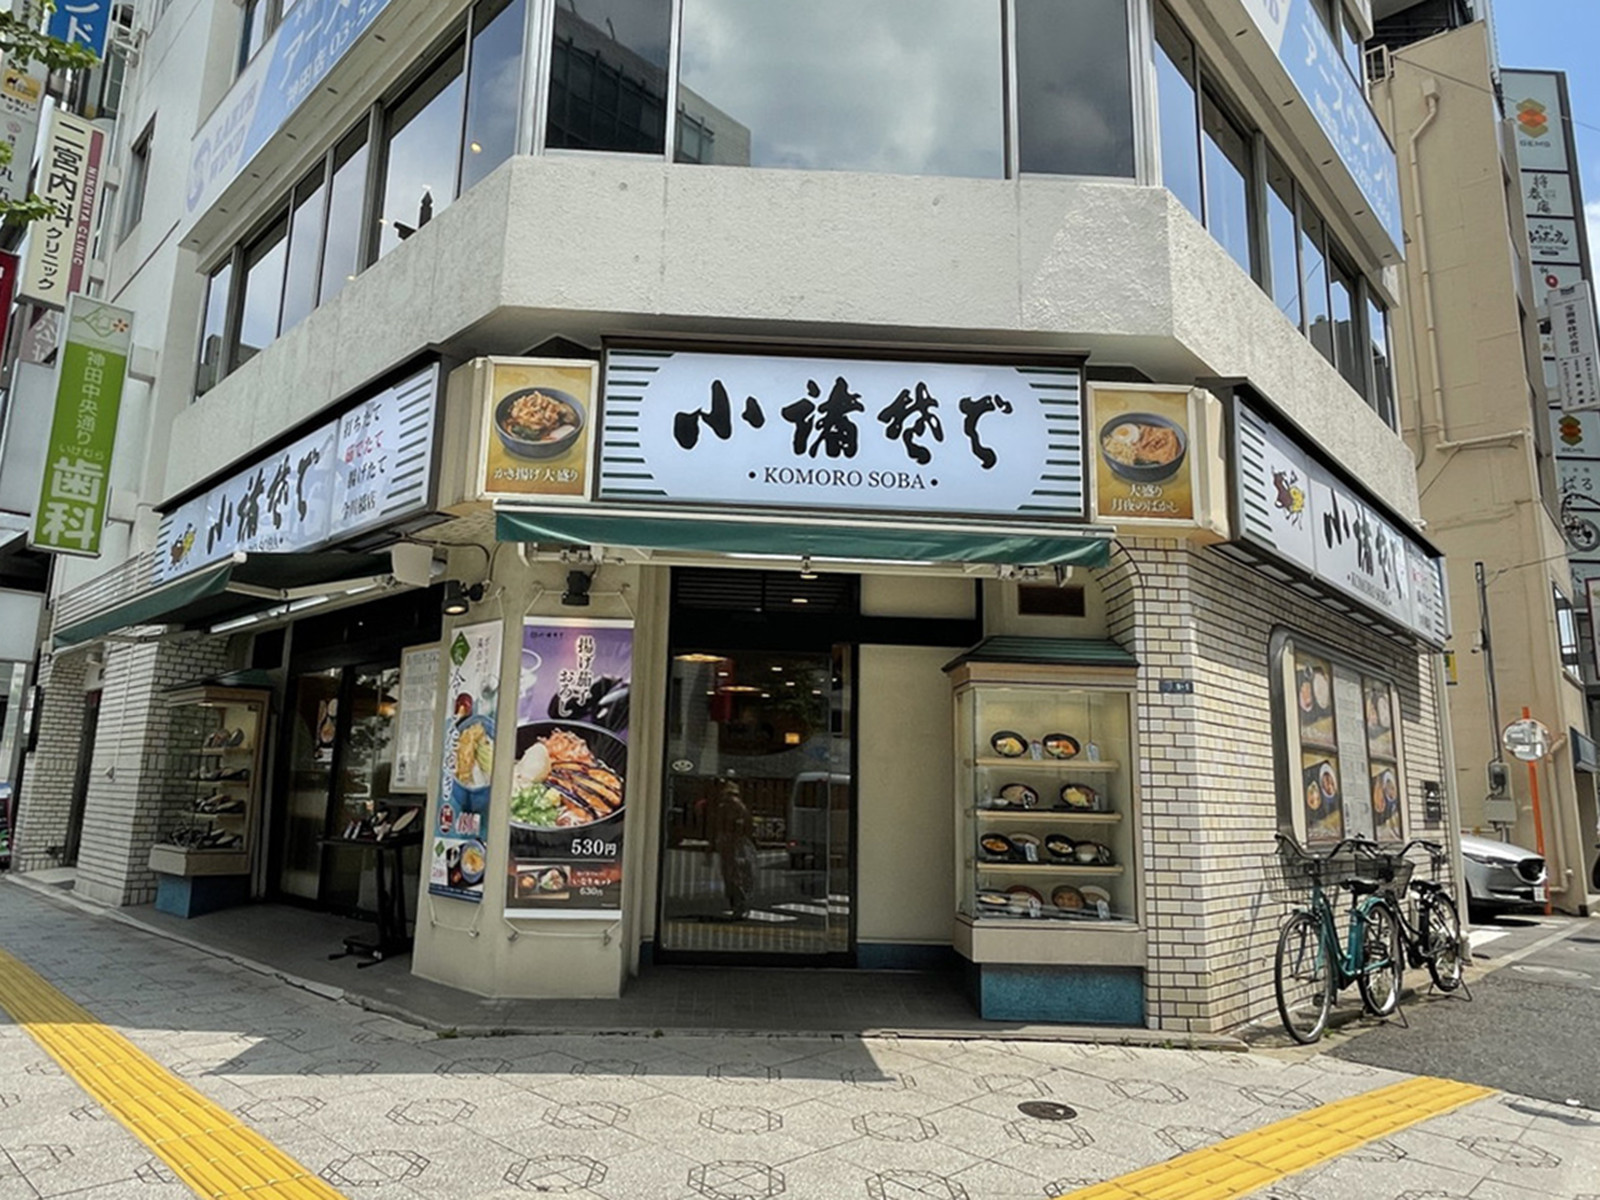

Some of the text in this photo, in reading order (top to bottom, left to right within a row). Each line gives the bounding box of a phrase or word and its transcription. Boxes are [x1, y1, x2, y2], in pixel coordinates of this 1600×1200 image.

[37, 121, 85, 291] 二宮内科クリニック
[73, 166, 98, 266] NINOMIYA CLINIC
[76, 351, 106, 446] 神田中央通り
[41, 456, 105, 550] 歯科
[764, 467, 926, 490] KOMORO SOBA
[571, 838, 617, 856] 530円
